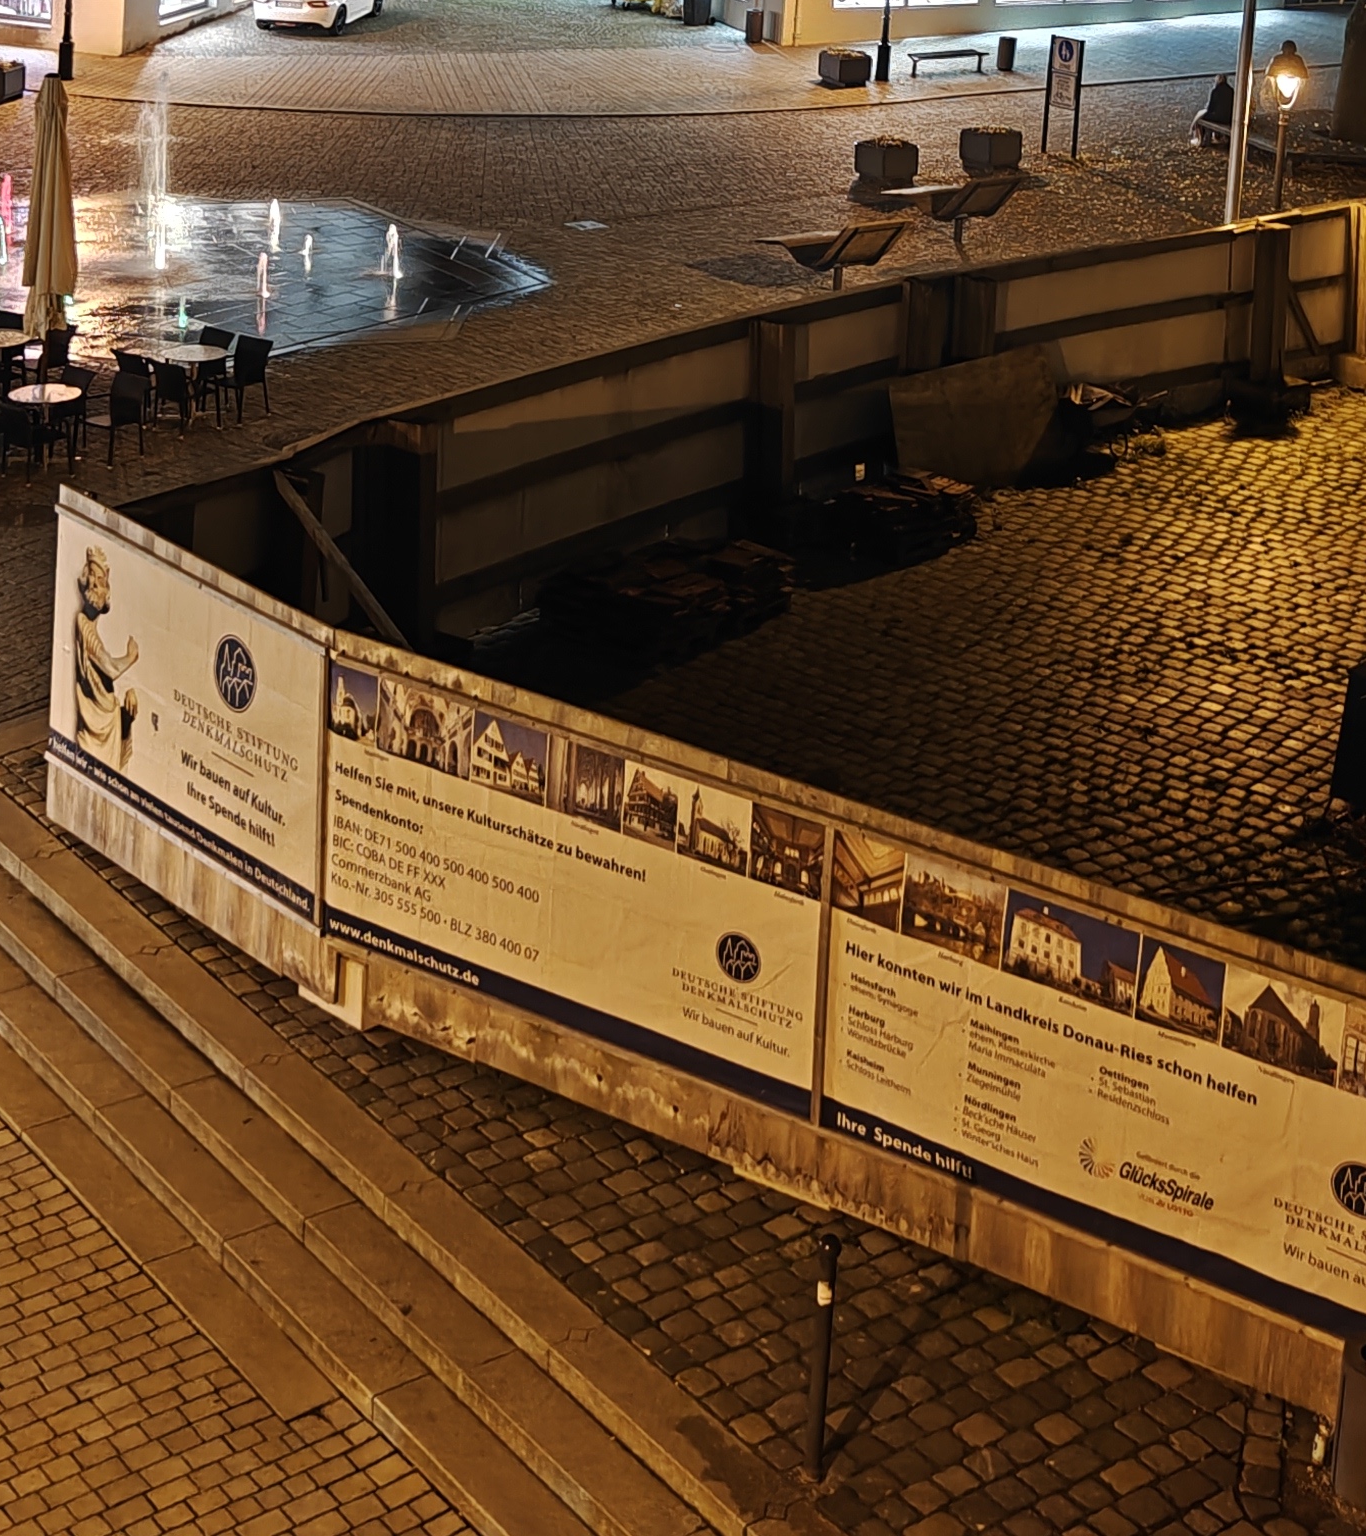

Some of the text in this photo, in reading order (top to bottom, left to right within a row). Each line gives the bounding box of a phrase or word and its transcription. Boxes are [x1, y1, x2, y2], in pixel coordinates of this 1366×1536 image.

[173, 689, 298, 771] DEUTSCHE STIFTUNG
[182, 711, 288, 782] DENKMALSCHUTZ
[181, 750, 286, 826] Wir bauen auf Kultur.
[187, 782, 276, 847] Ihre Spende hilft!
[335, 789, 424, 835] Spendenkonto:
[335, 761, 646, 883] Helfen Sie mit, unsere Kulturschätze zu bewahren!
[195, 831, 244, 870] Denkmalen
[244, 860, 254, 876] in
[255, 867, 311, 912] Deutschland.
[331, 853, 432, 903] Commerzbank AG
[332, 834, 446, 890] BIC: COBA DE FF XXX
[334, 815, 540, 904] IBAN: DE71 500 400 500 400 500 400
[331, 872, 540, 962] Kto.-Nr. 305 555 500 BLZ 380 400 07
[329, 918, 480, 986] www.denkmalschutz.de
[672, 967, 804, 1022] DEUTSCHE STIFTUNG
[851, 971, 896, 998] Hainsfarth
[681, 982, 793, 1030] DENKMALSCHUTZ
[845, 940, 1257, 1106] Hier konnten wir im Landkreis Donau-Ries schon helfen
[848, 1004, 885, 1028] Harburg
[877, 994, 918, 1018] Synagoge
[682, 1006, 790, 1058] Wir bauen auf Kultur.
[848, 1016, 914, 1052] Schloss Harburg
[970, 1018, 1020, 1045] Maihingen
[846, 1049, 885, 1073] Kaisheim
[967, 1061, 1021, 1090] Munningen
[968, 1040, 1046, 1079] Maria Immaculata
[998, 1040, 1056, 1069] Klosterkirche
[846, 1059, 911, 1096] Schloss Leitheim
[966, 1072, 1021, 1102] Ziegelmühle
[1099, 1065, 1150, 1092] Oettingen
[1112, 1082, 1156, 1107] Sebastian
[964, 1093, 1017, 1123] Nördlingen
[837, 1111, 972, 1180] Ihre Spende hilft!
[973, 1123, 1001, 1142] Georg
[1006, 1123, 1036, 1143] Häuser
[1119, 1161, 1214, 1211] GlücksSpirale
[1273, 1197, 1356, 1236] DEUTSCHE
[1283, 1242, 1305, 1260] Wir
[1308, 1251, 1350, 1281] bauen
